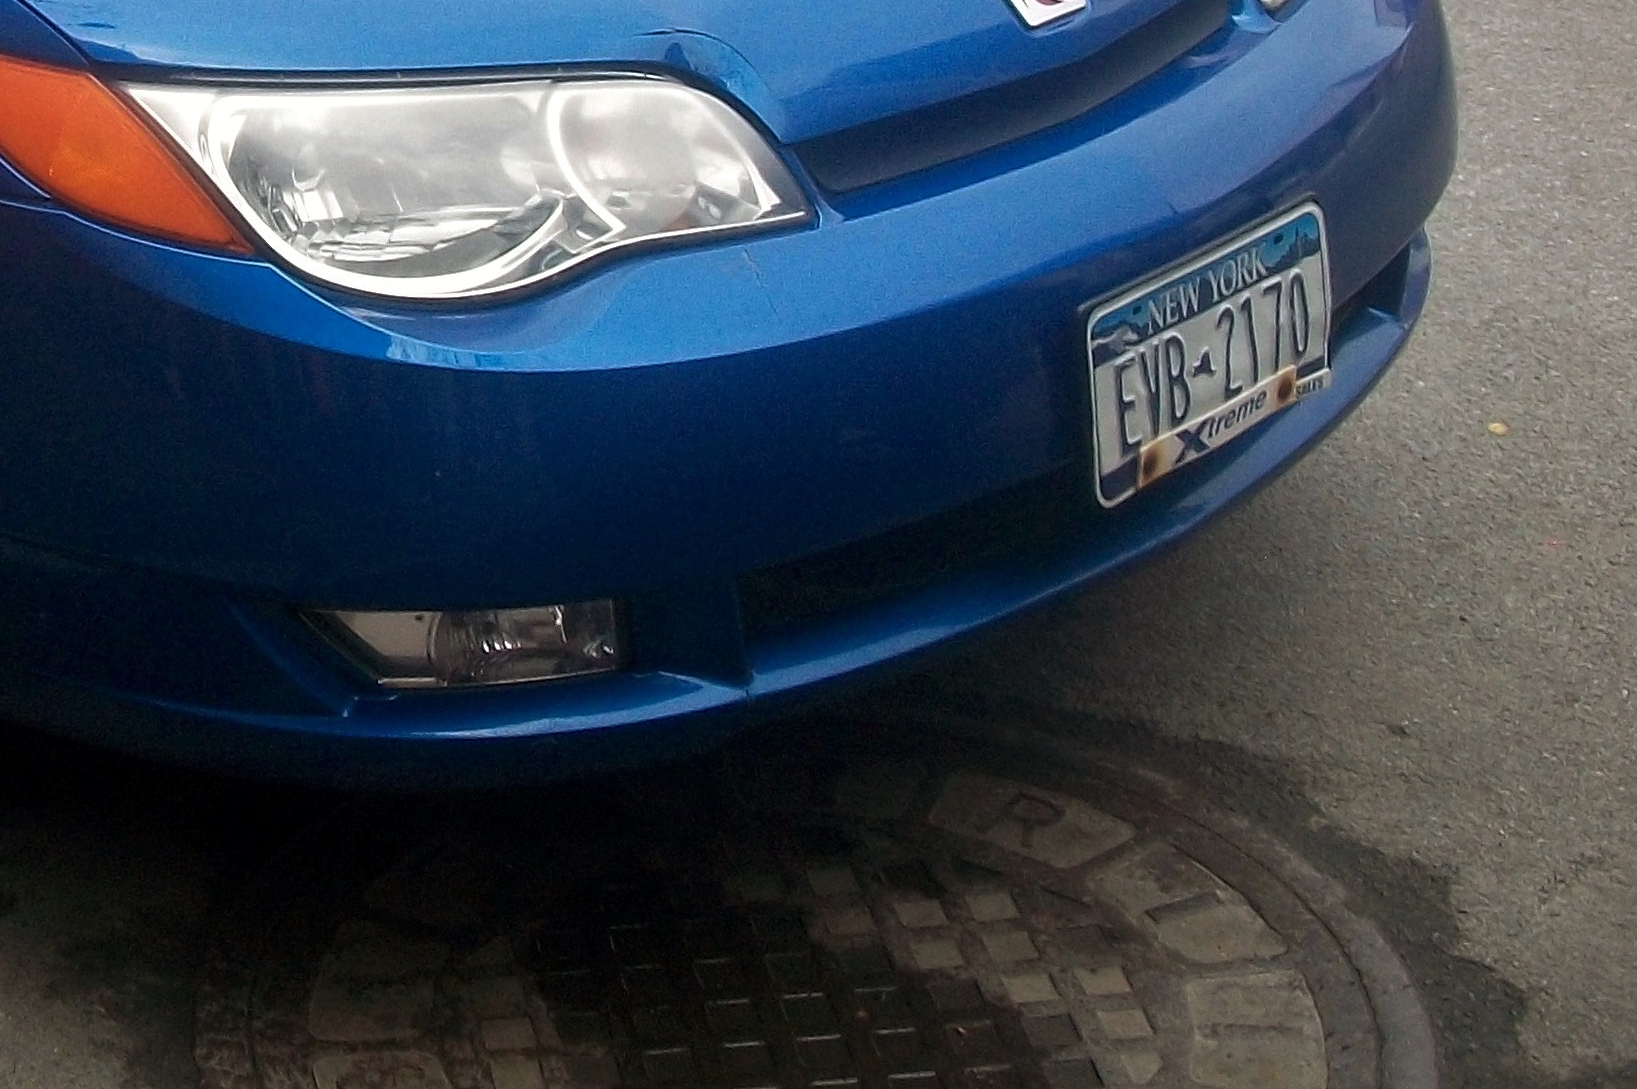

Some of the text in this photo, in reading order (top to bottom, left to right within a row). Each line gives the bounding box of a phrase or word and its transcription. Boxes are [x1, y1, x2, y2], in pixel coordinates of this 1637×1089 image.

[1147, 247, 1269, 337] NEW YORK
[1174, 388, 1268, 464] Xtreme
